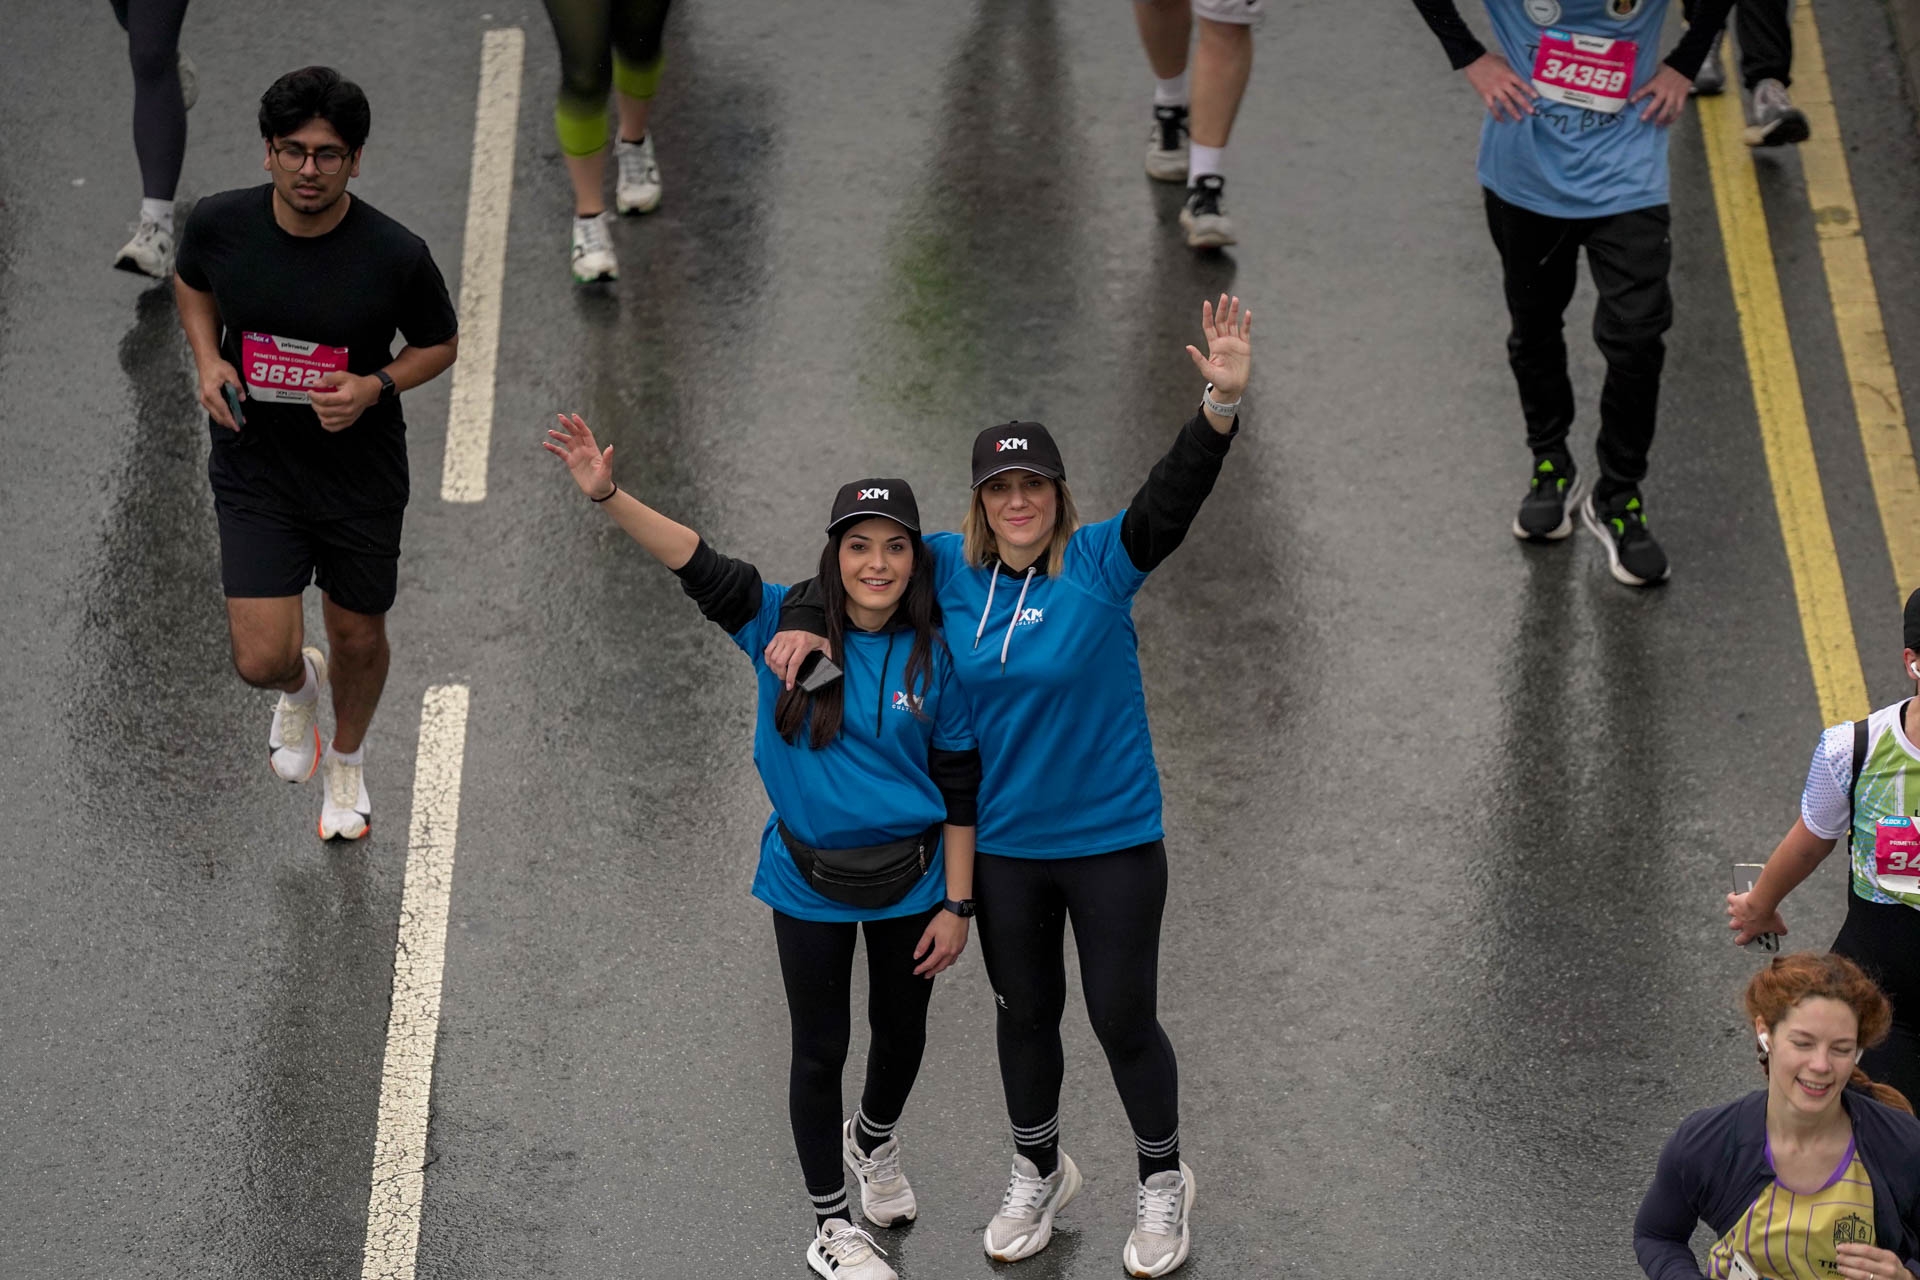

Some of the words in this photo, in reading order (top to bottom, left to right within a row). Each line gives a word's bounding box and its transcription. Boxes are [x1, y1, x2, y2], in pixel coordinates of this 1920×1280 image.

[1541, 58, 1627, 93] 34359
[281, 342, 309, 352] primetel
[253, 352, 277, 361] PRIMETEL
[996, 437, 1028, 452] XM
[857, 488, 889, 501] XM
[1018, 608, 1044, 621] XM
[892, 691, 924, 710] XM
[891, 704, 915, 713] CULT
